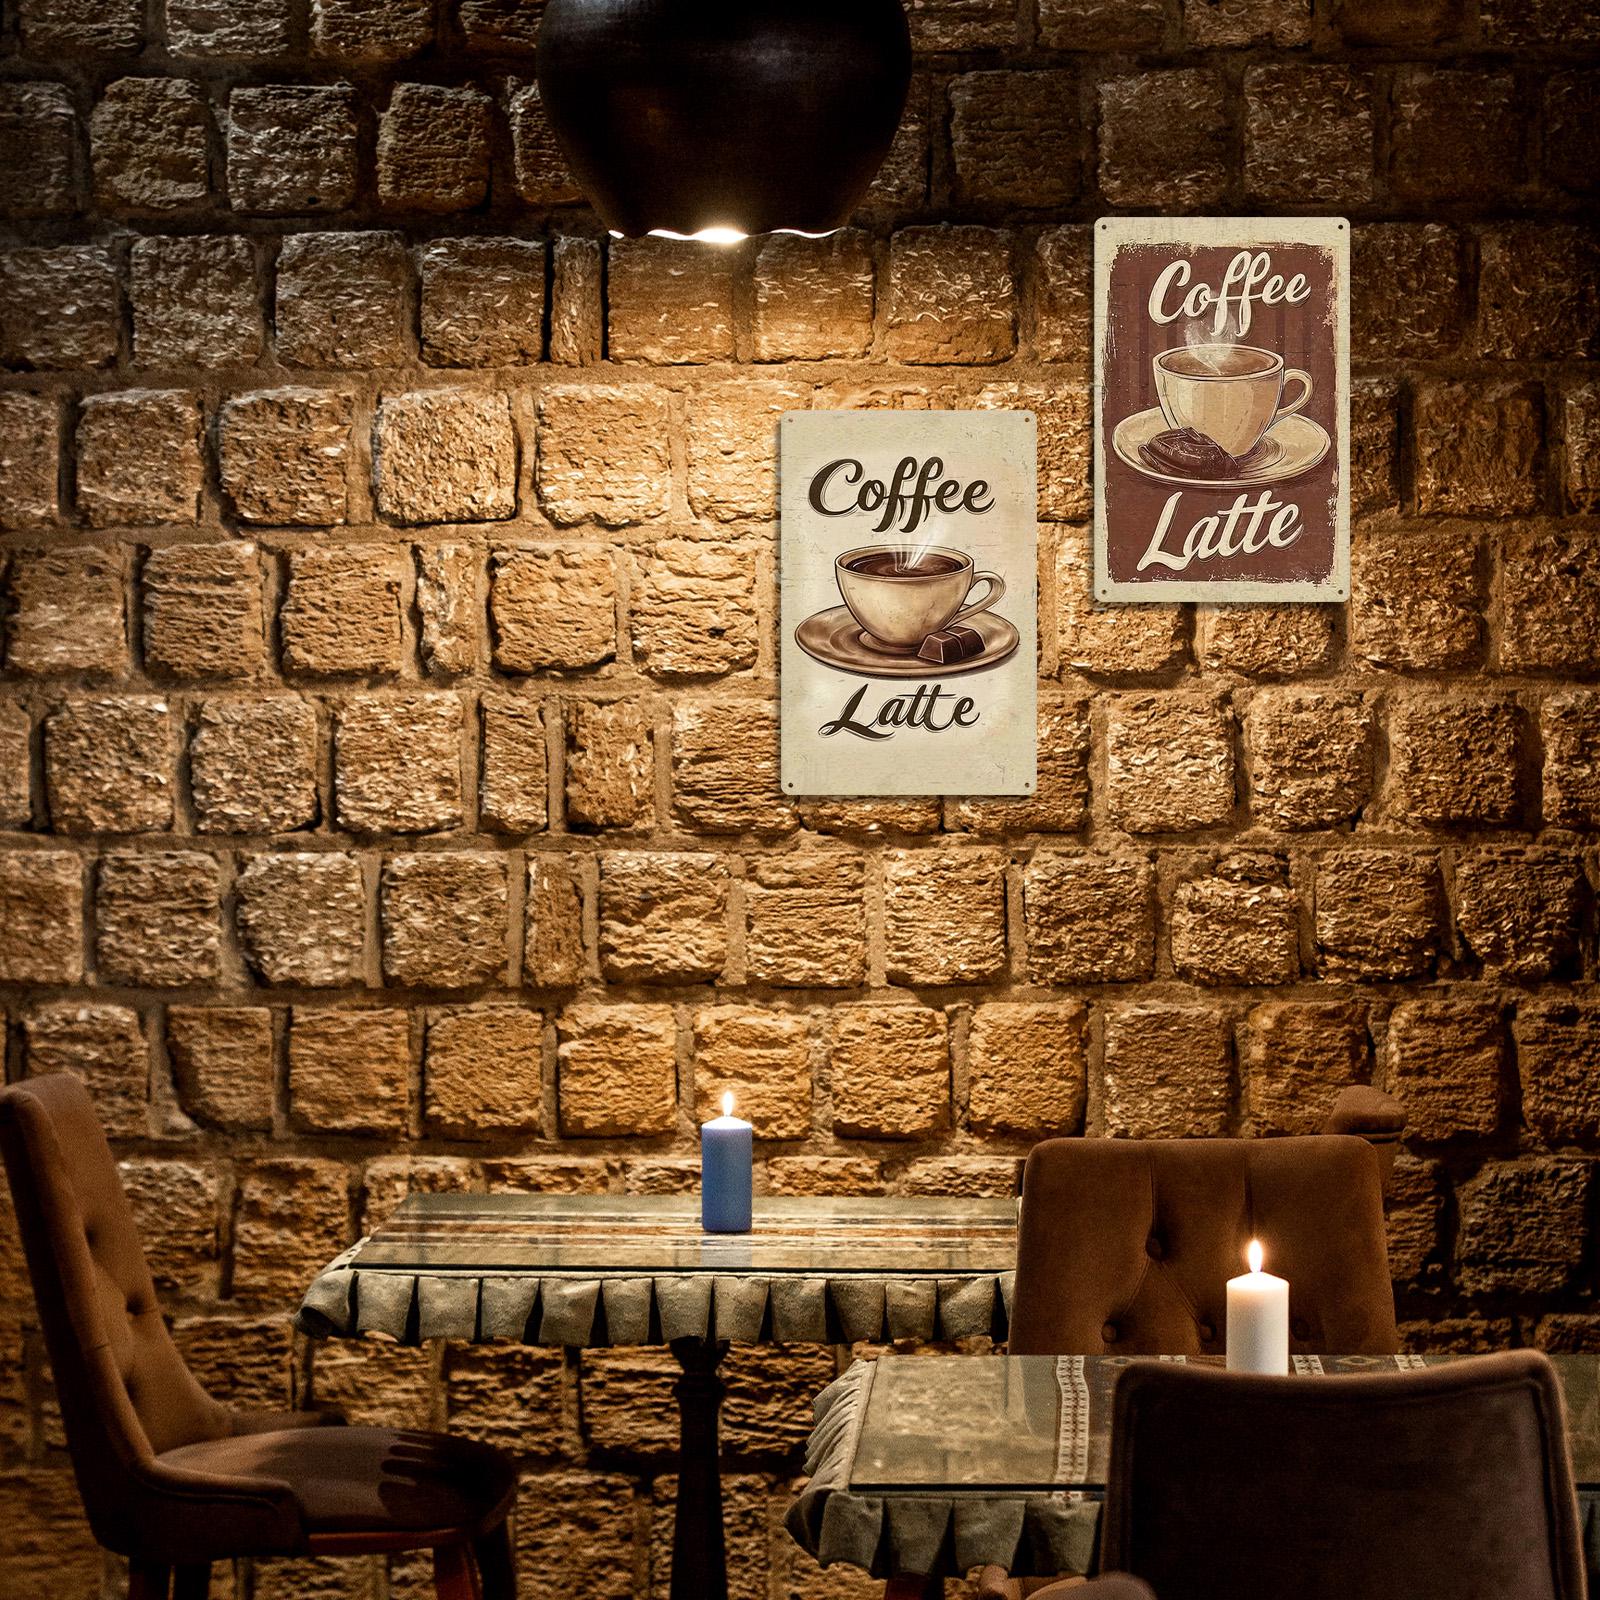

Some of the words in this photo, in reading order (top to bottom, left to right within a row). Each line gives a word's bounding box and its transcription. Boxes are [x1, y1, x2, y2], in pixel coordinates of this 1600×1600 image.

[1148, 251, 1312, 337] Coffee
[808, 456, 996, 533] Coffee
[1137, 490, 1304, 571] Latte
[818, 683, 980, 740] Latte
